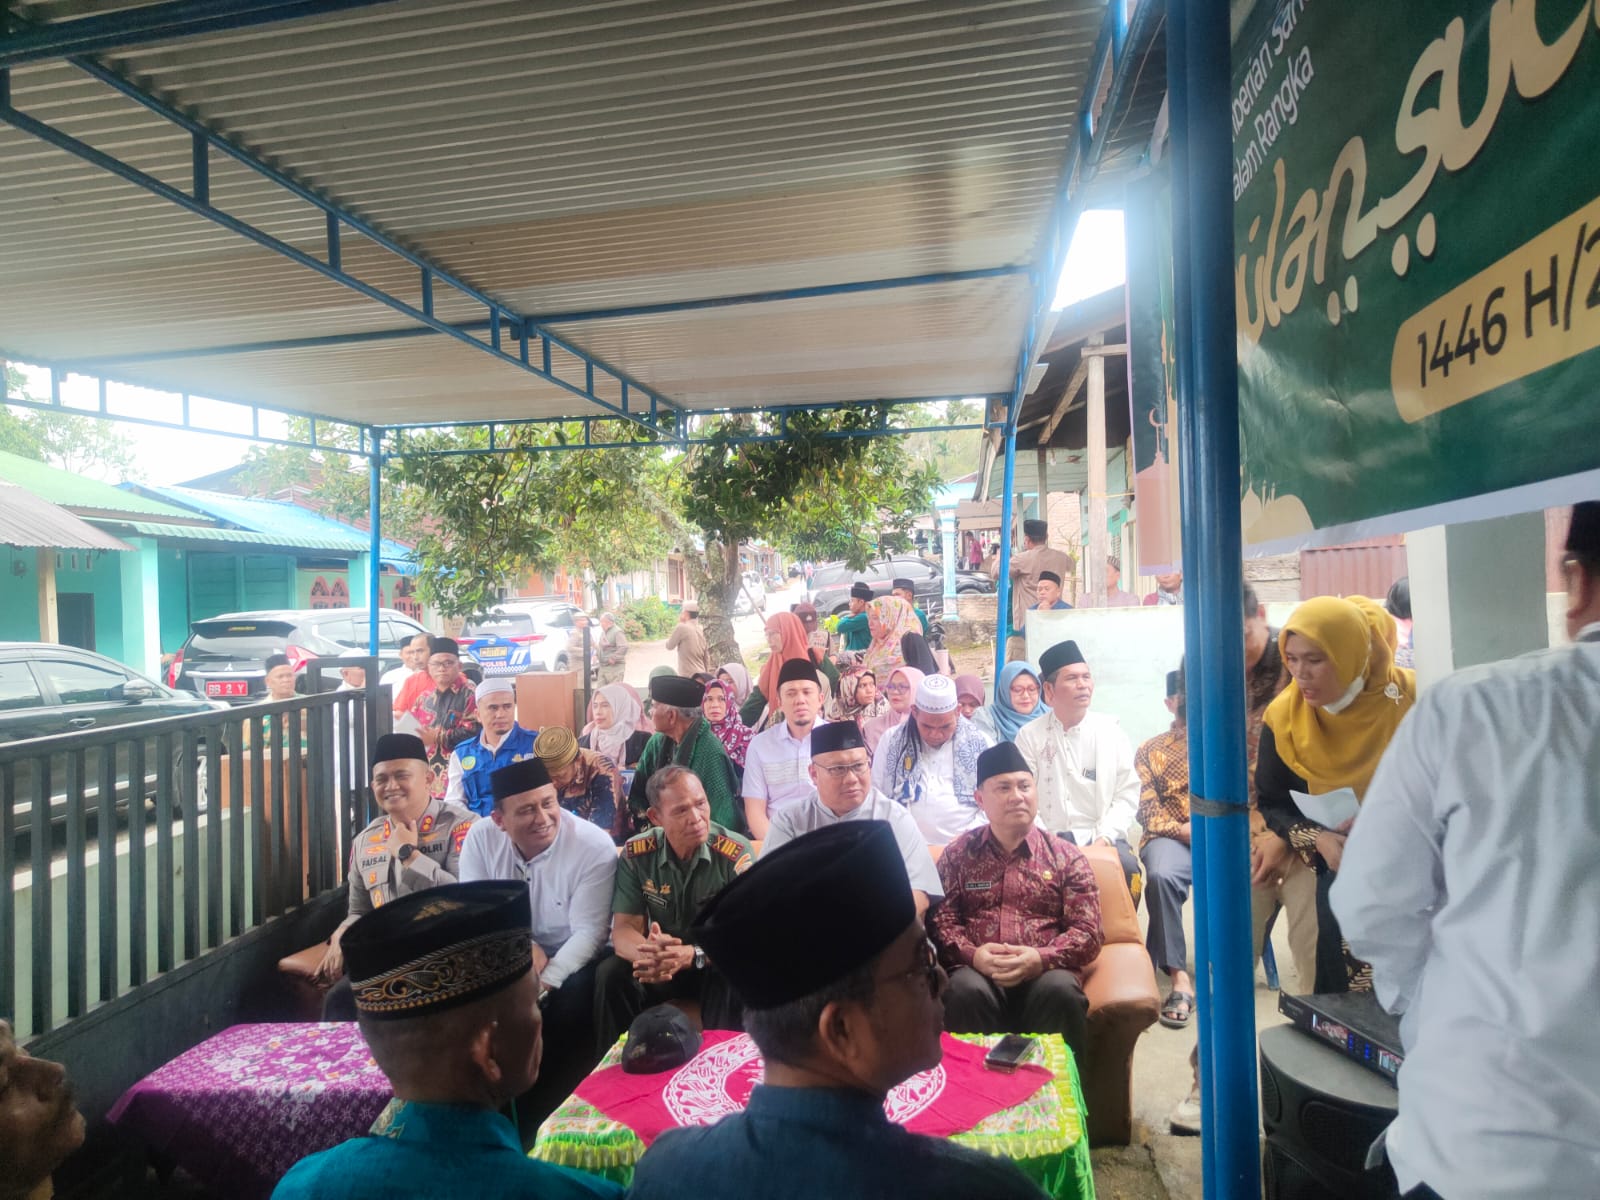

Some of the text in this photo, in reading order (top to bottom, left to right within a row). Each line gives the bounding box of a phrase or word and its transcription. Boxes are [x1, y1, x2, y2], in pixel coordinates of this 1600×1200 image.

[1232, 41, 1273, 142] berian
[1232, 46, 1315, 201] alam Rangka
[1417, 286, 1507, 388] 1446
[208, 684, 244, 695] BB 2 Y
[362, 856, 387, 868] FAISAL
[420, 843, 443, 854] OLRI
